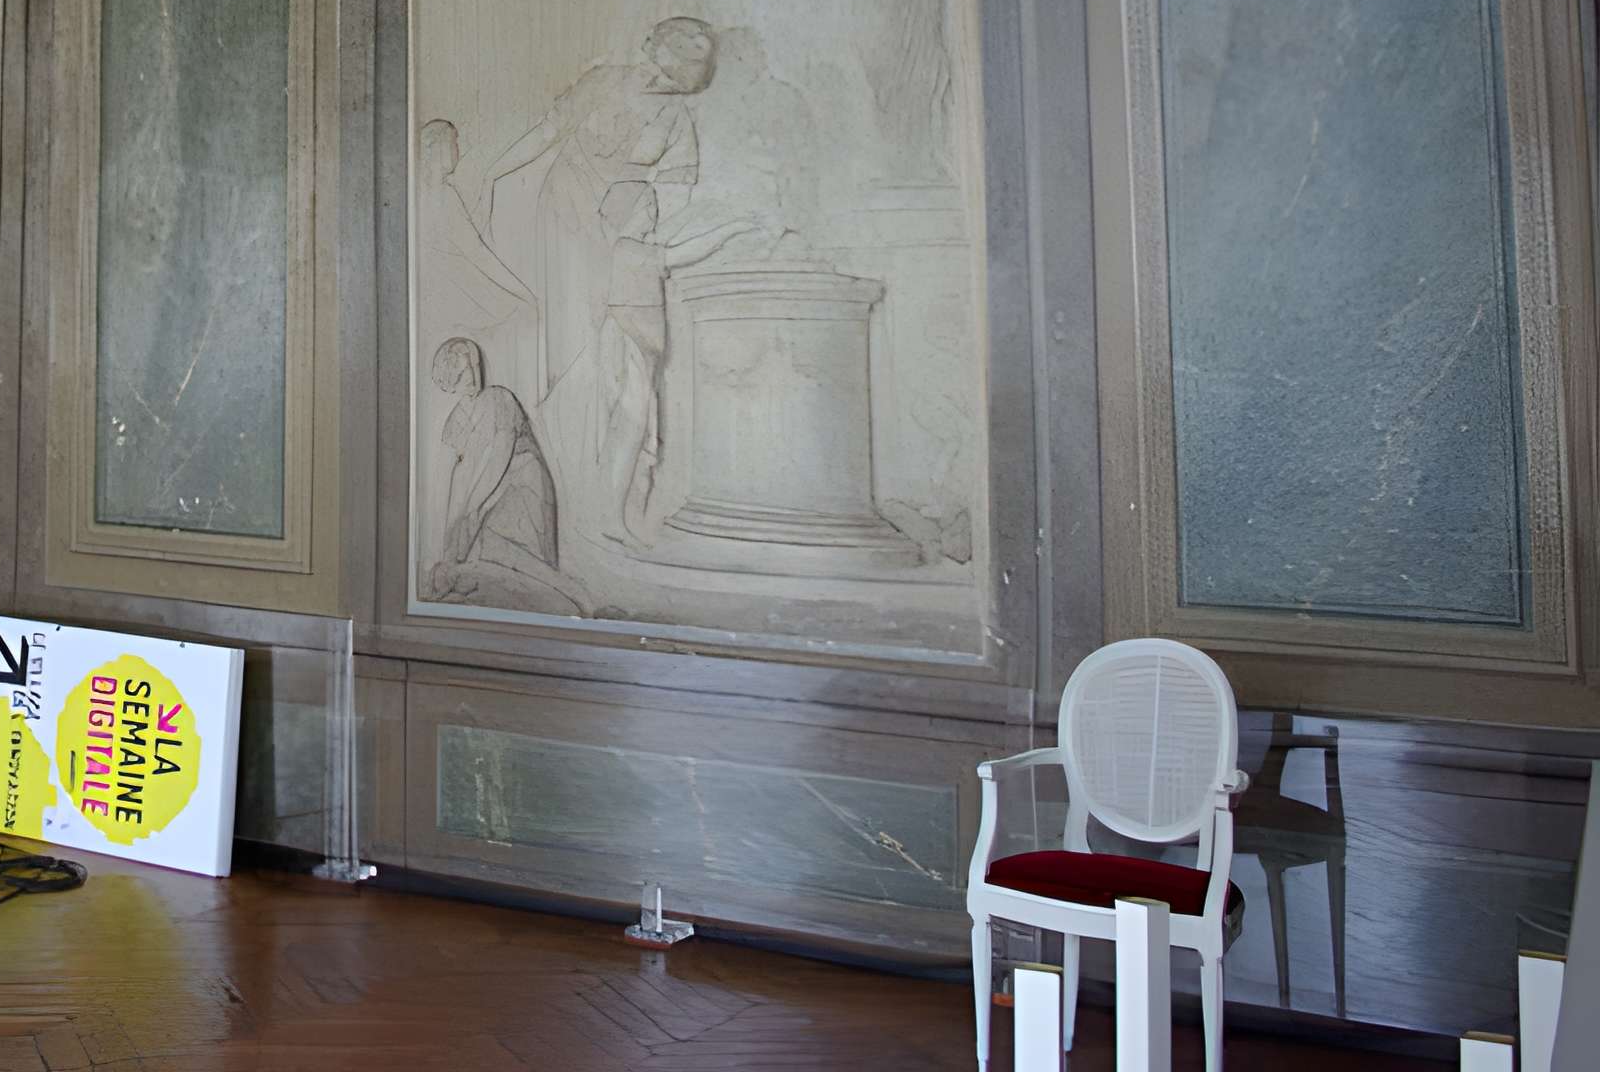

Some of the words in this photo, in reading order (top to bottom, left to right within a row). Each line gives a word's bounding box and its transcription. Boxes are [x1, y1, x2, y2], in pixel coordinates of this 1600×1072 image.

[81, 676, 118, 816] DIGITALE
[115, 679, 151, 824] SEMAINE
[152, 738, 182, 775] LA
